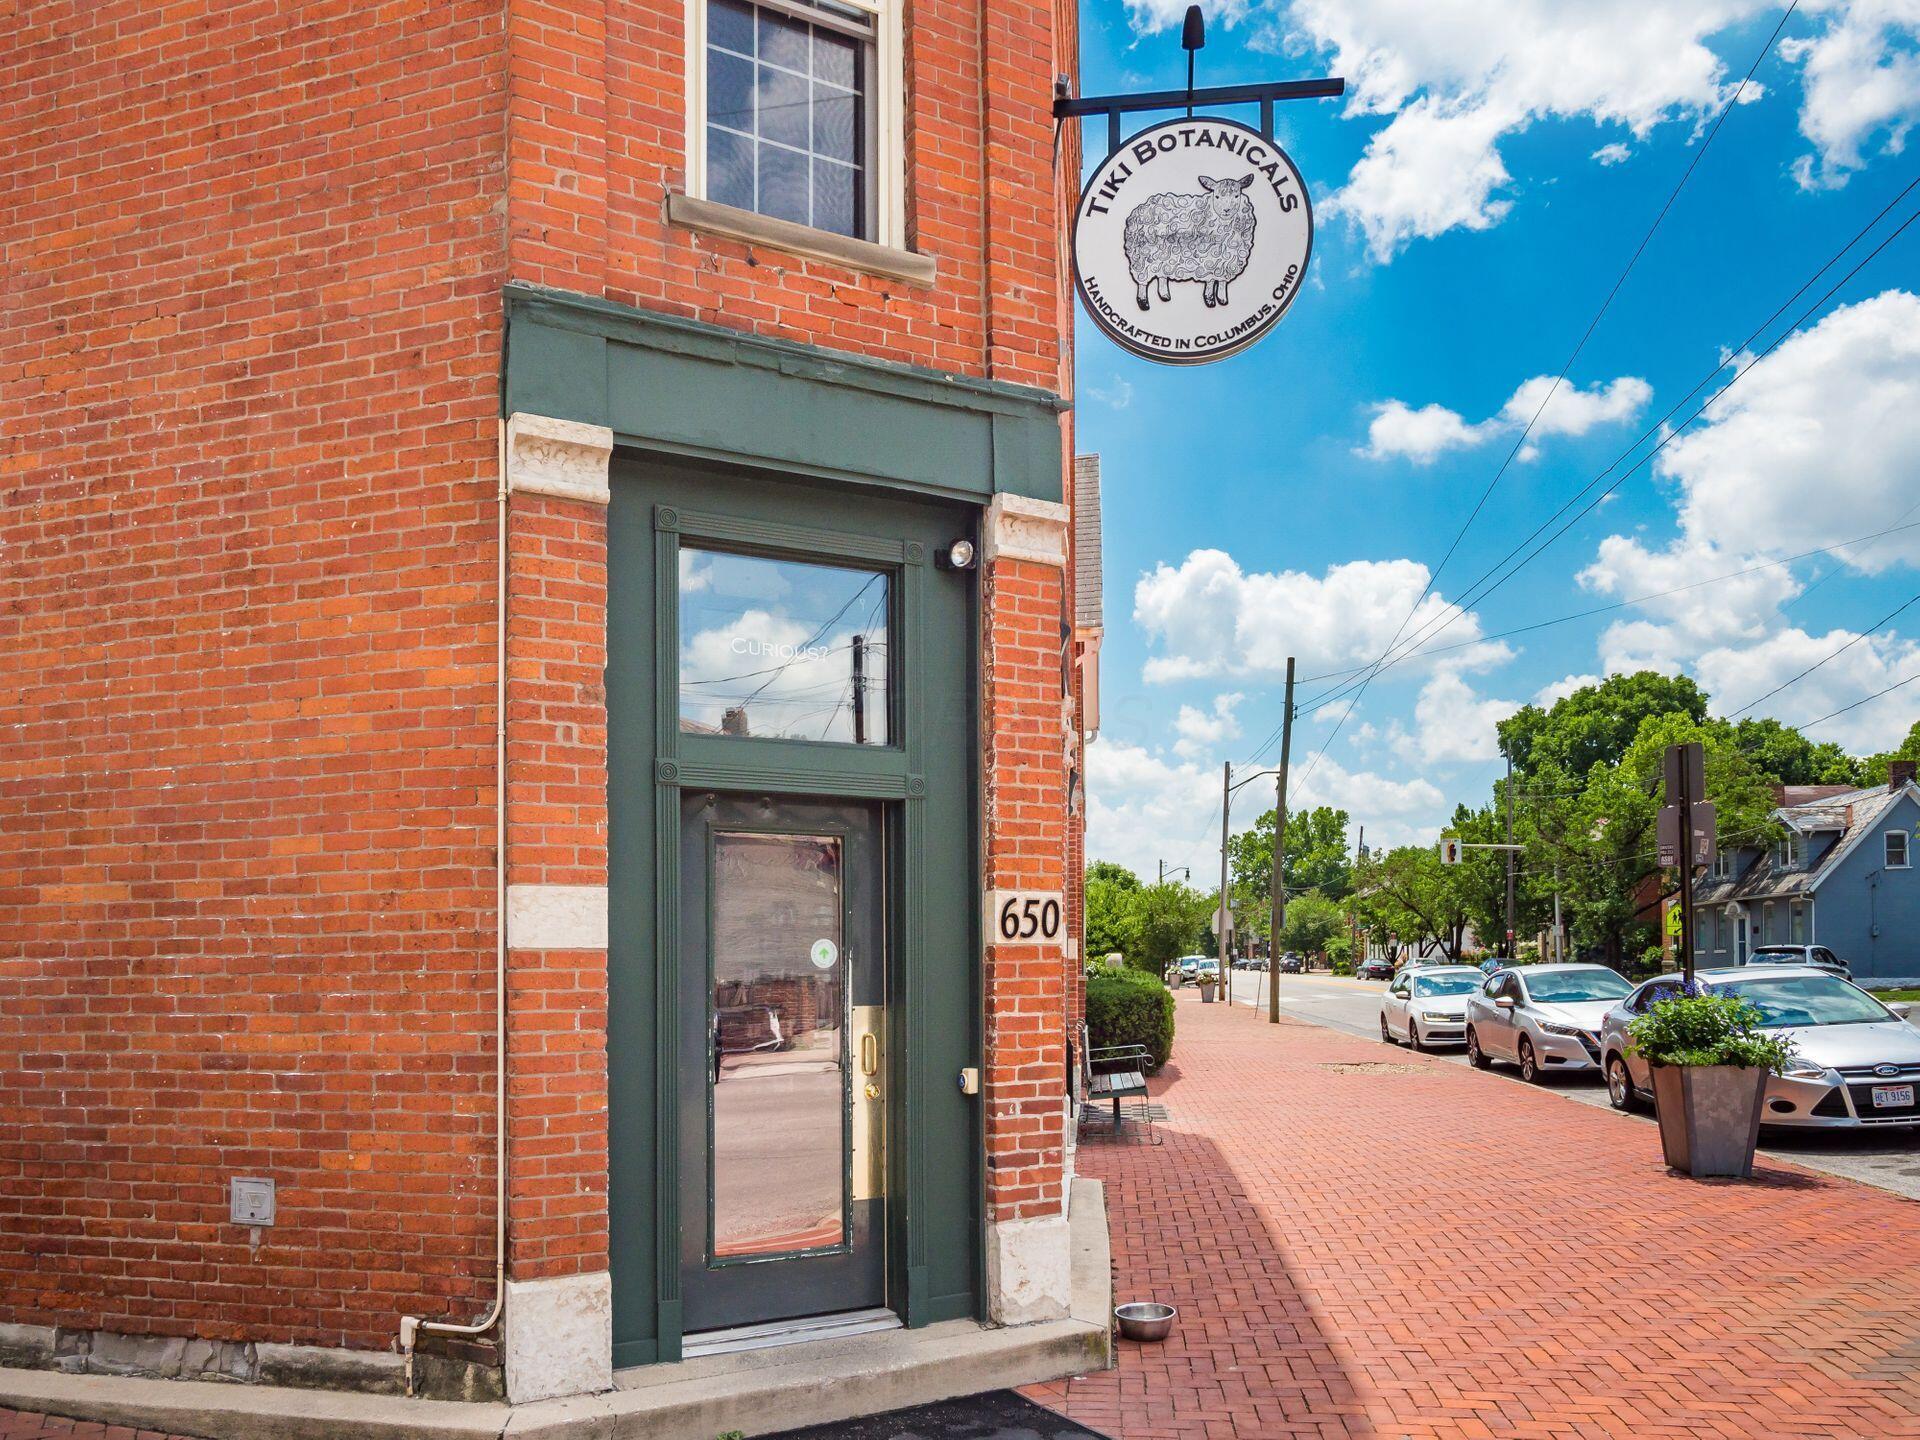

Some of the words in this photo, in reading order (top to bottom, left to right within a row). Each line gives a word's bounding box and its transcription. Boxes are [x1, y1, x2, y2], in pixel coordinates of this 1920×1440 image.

[1086, 161, 1133, 217] TIKI
[1132, 129, 1298, 214] BOTANICALS
[1084, 276, 1172, 348] HANDCRAFTED
[1175, 338, 1190, 349] IN
[1194, 303, 1277, 348] COLUMBUS,
[1272, 264, 1298, 301] OHIO
[1001, 898, 1059, 938] 650
[1891, 1091, 1911, 1101] 9156
